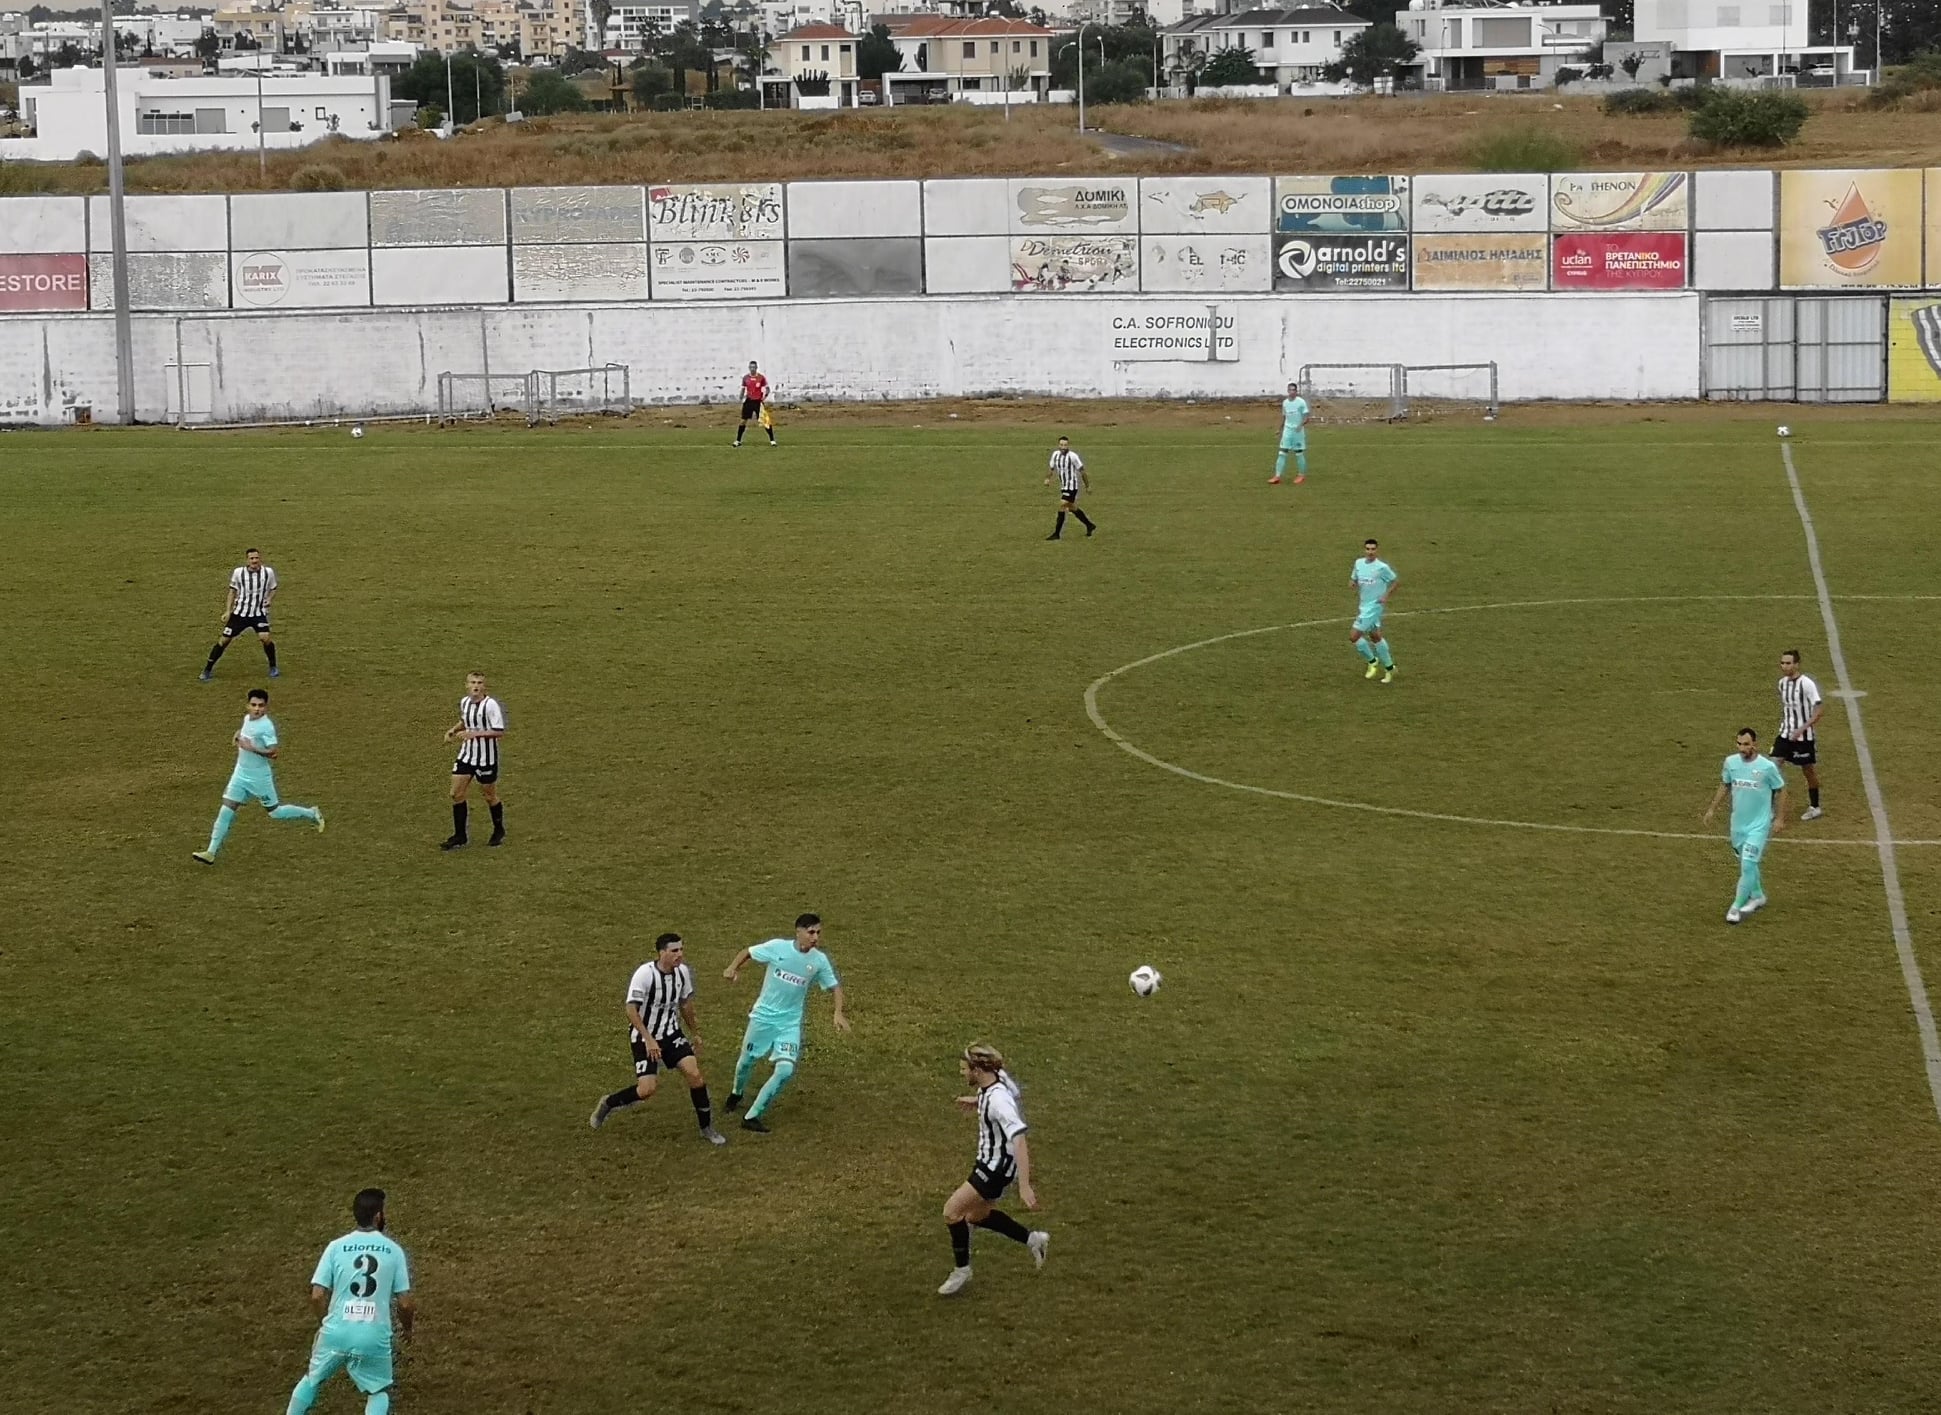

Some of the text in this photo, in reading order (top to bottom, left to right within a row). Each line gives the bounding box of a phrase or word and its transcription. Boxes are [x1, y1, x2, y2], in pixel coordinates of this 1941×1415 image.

[1317, 240, 1406, 262] arnold's
[1606, 252, 1659, 261] ΒΡΕΤΑΝΙΚΟ
[1316, 262, 1406, 274] digital printers ltd
[1606, 261, 1680, 270] ΠΑΝΕΠΙΣΤΗΜΙΟ
[245, 272, 277, 280] KARIX
[1112, 317, 1140, 329] C.A.
[1114, 337, 1202, 348] ELECTRONICS
[349, 1253, 379, 1298] 3
